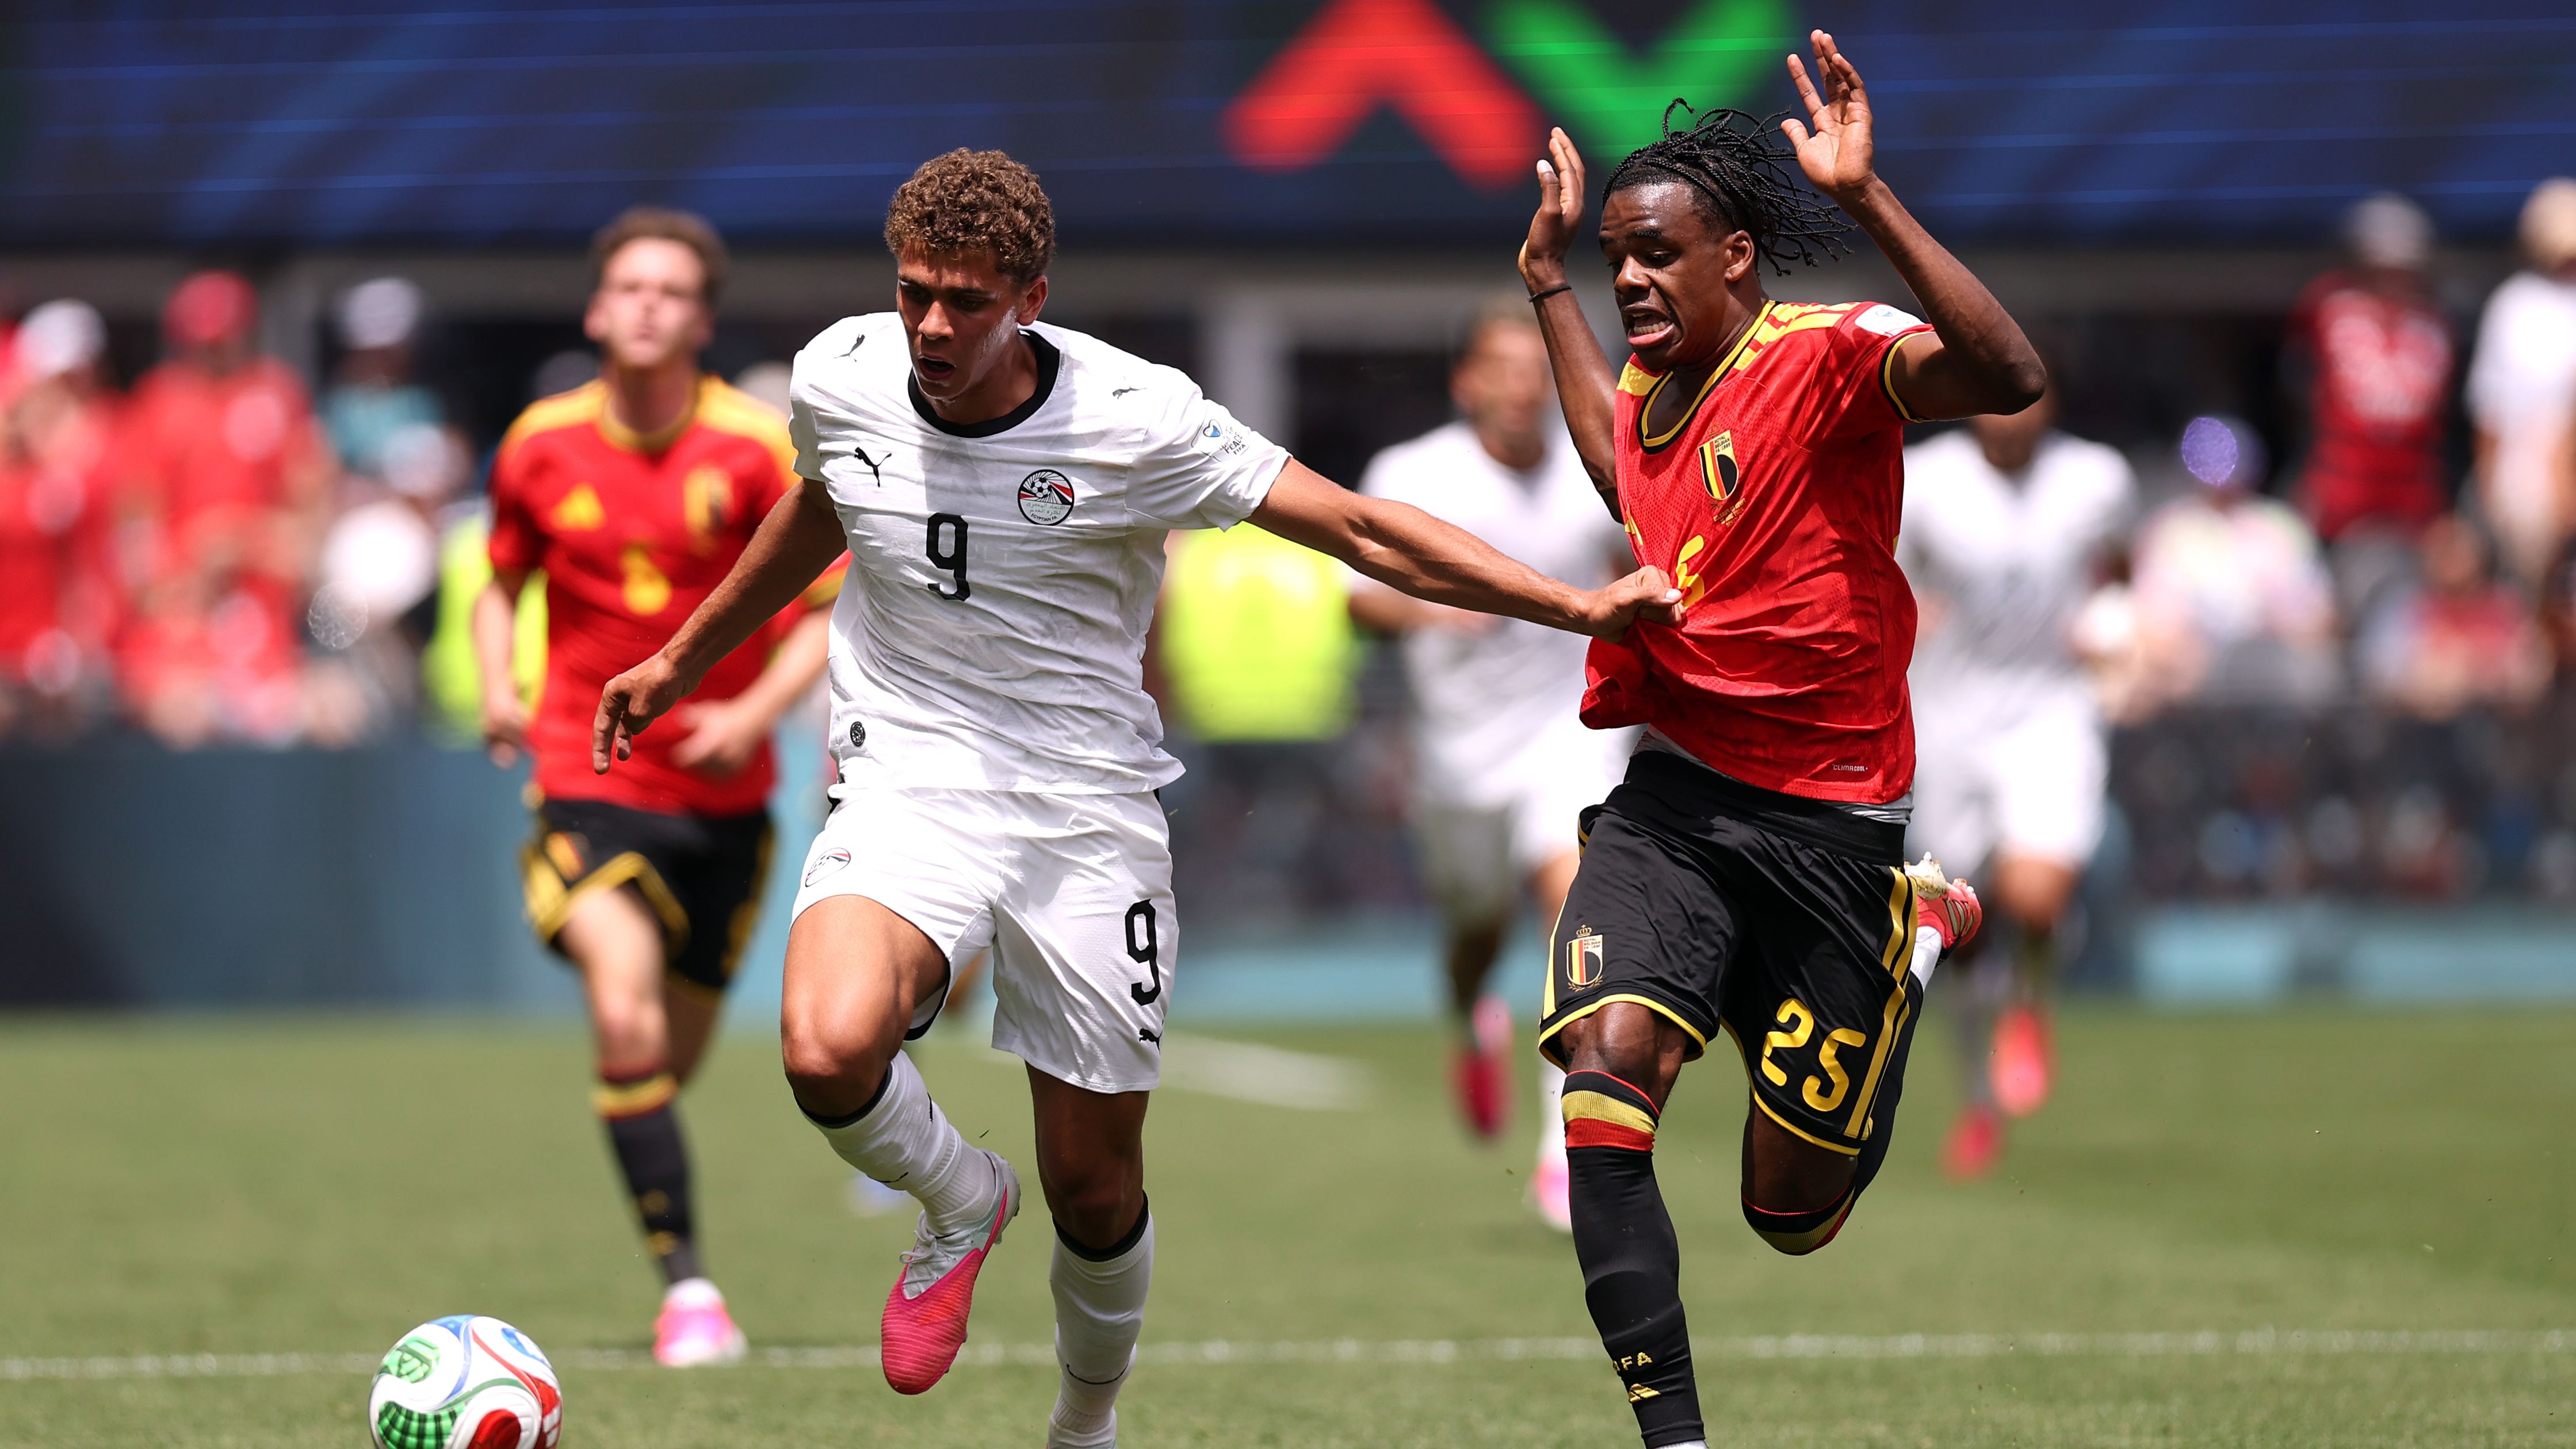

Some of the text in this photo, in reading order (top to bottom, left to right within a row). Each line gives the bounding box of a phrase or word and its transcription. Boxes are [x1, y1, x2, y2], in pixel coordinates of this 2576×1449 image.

[1224, 431, 1243, 454] PEACE
[1233, 444, 1245, 455] FIFA
[1031, 513, 1051, 521] EGYPTIAN
[926, 512, 970, 602] 9
[1676, 535, 1704, 610] 5
[1125, 899, 1161, 1006] 9
[1761, 997, 1866, 1112] 25
